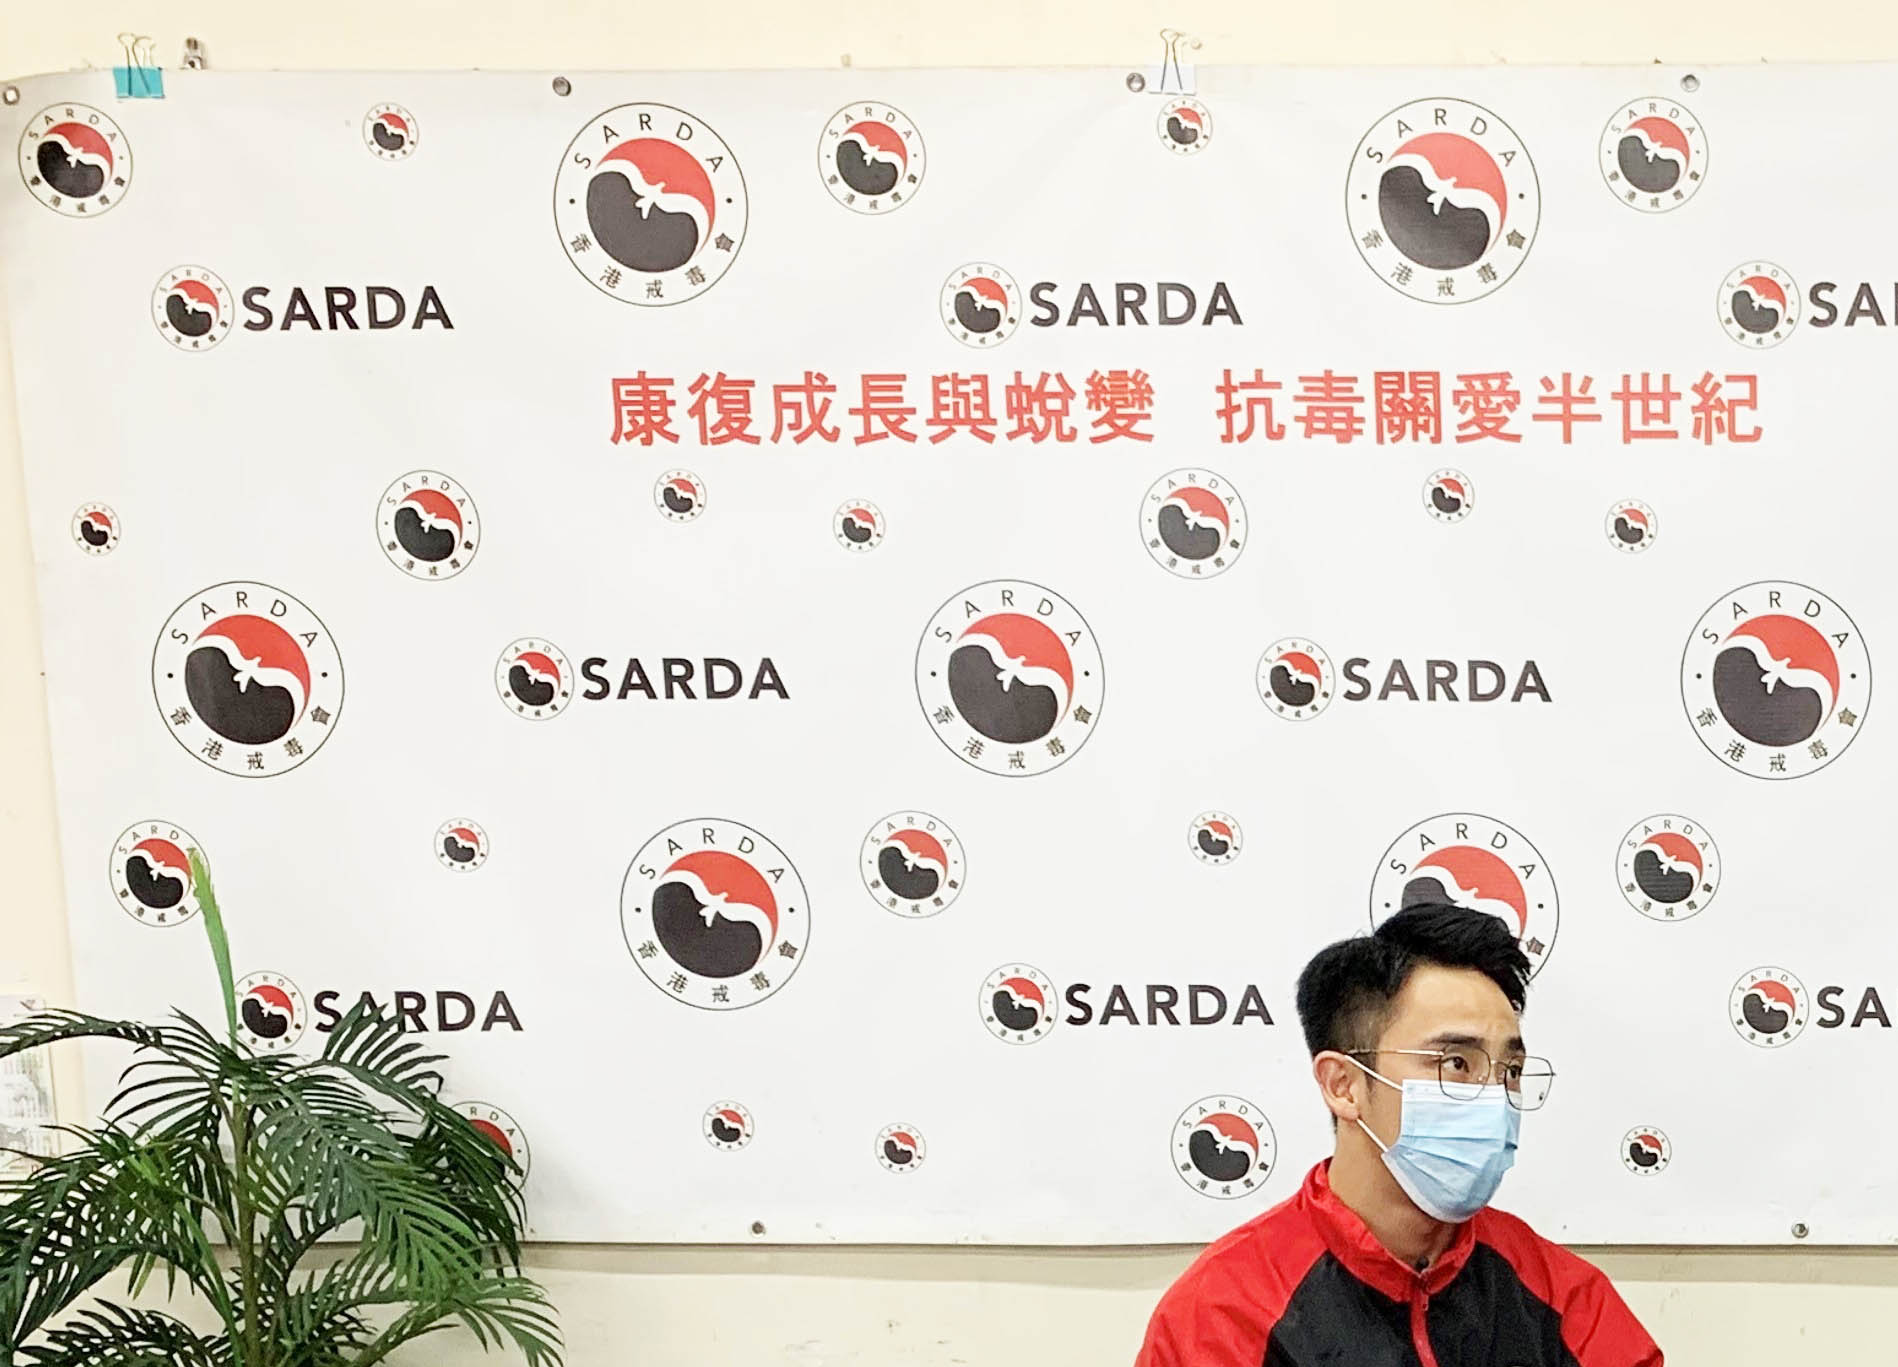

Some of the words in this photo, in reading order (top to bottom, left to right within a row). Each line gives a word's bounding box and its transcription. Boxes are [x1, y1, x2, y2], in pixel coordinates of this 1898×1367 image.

[29, 107, 117, 142] SARDA
[828, 106, 912, 140] SARDA
[1366, 108, 1516, 167] SARDA
[1611, 102, 1695, 136] SARDA
[574, 113, 724, 173] SARDA
[570, 232, 735, 299] 香港戒毒會
[1361, 228, 1526, 296] 香港戒毒會
[243, 286, 454, 331] SARDA
[1031, 282, 1242, 327] SARDA
[611, 370, 1153, 446] 康復成長與蛻變
[1216, 369, 1762, 444] 抗毒關愛半世紀
[386, 475, 466, 508] SARDA
[1151, 473, 1235, 506] SARDA
[171, 591, 318, 648] SARDA
[935, 589, 1082, 647] SARDA
[1702, 591, 1849, 649] SARDA
[582, 658, 789, 700] SARDA
[1343, 658, 1552, 702] SARDA
[170, 705, 331, 770] 香港戒毒會
[933, 704, 1093, 769] 香港戒毒會
[1696, 707, 1858, 772] 香港戒毒會
[870, 816, 953, 847] SARDA
[1390, 822, 1536, 880] SARDA
[1627, 819, 1708, 851] SARDA
[639, 827, 785, 884] SARDA
[637, 940, 798, 1003] 香港戒毒會
[314, 991, 523, 1032] SARDA
[1066, 984, 1274, 1025] SARDA
[470, 1106, 515, 1136] RDA
[1182, 1100, 1264, 1131] SARDA
